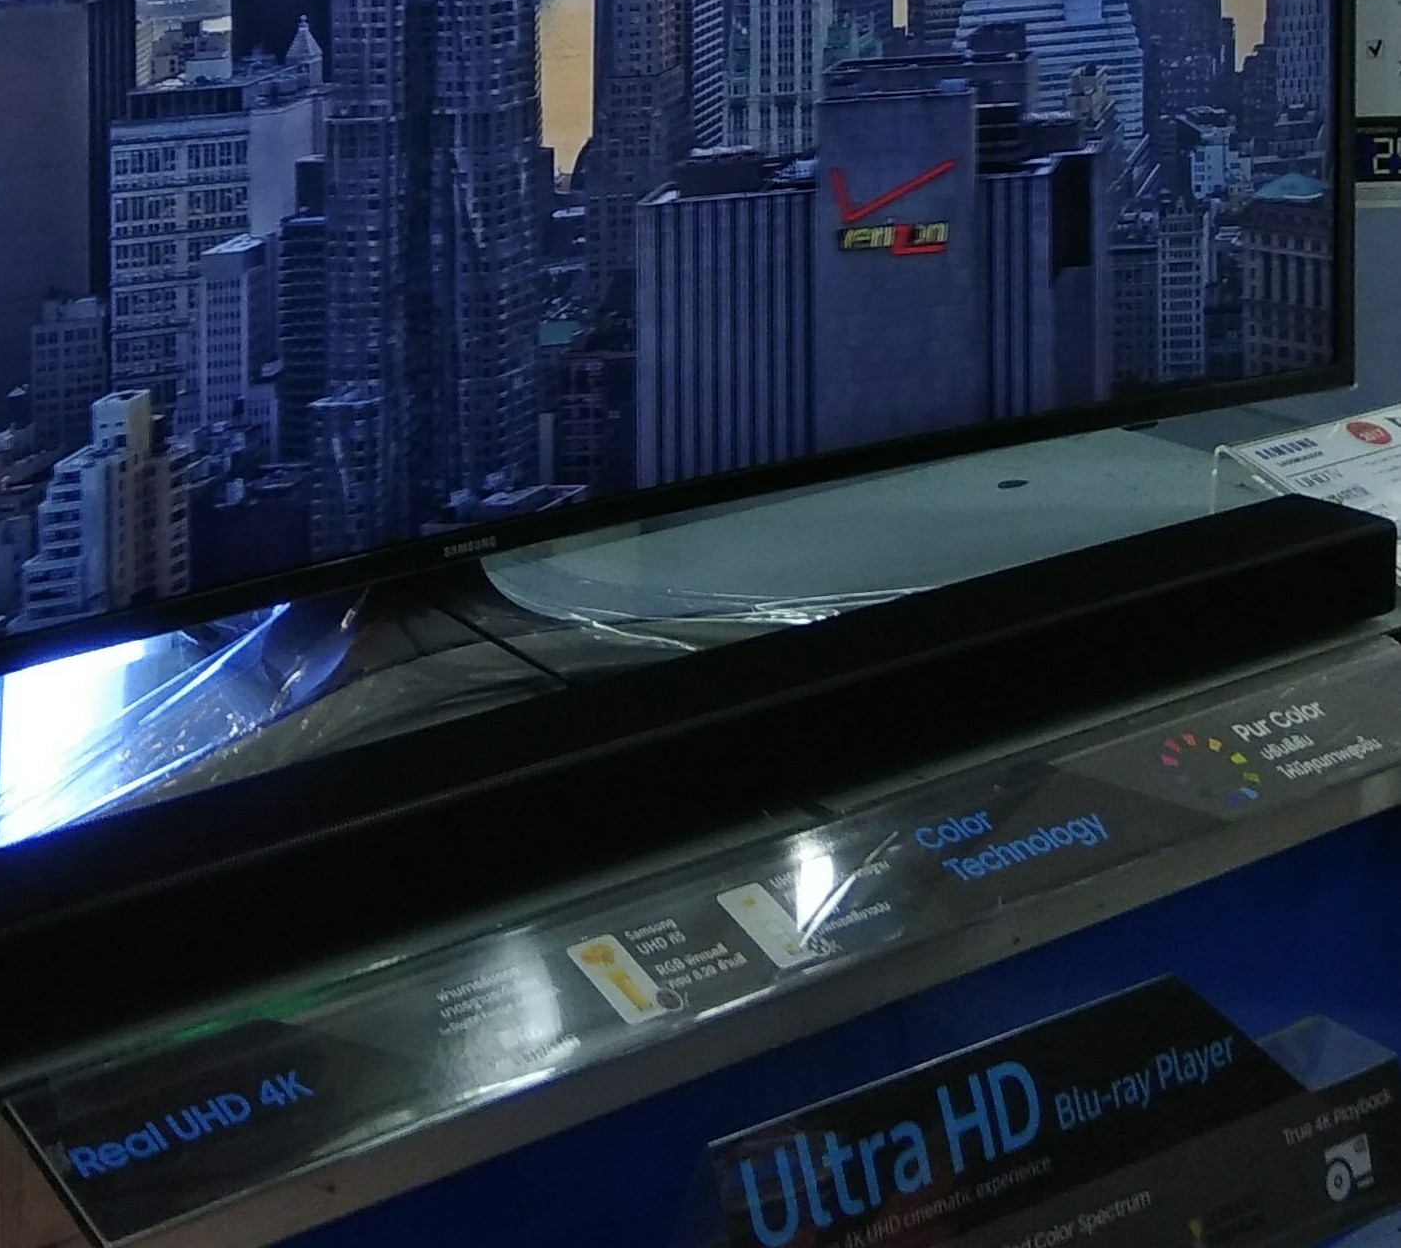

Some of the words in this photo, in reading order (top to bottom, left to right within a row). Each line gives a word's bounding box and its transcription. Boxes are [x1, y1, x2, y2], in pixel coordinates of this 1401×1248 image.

[443, 535, 497, 558] SAMSUNG
[1230, 718, 1272, 743] Pur
[1268, 701, 1327, 729] Color
[914, 810, 994, 851] Color
[942, 812, 1111, 883] Technology
[624, 917, 679, 941] Samsung
[636, 936, 667, 956] UHD
[654, 956, 686, 977] RGB
[67, 1120, 169, 1179] Real
[165, 1092, 252, 1142] UHD
[258, 1068, 316, 1109] 4K
[1281, 1122, 1314, 1147] True
[1314, 1113, 1332, 1132] 4K
[1332, 1087, 1395, 1126] Playback
[740, 1118, 935, 1248] Ultra
[935, 1058, 1042, 1177] HD
[1053, 1069, 1153, 1133] Blu-ray
[1155, 1033, 1235, 1092] Player
[866, 1214, 901, 1240] UHD
[902, 1189, 972, 1227] cinematic
[1034, 1217, 1075, 1248] Color
[1076, 1187, 1153, 1235] Spectrum
